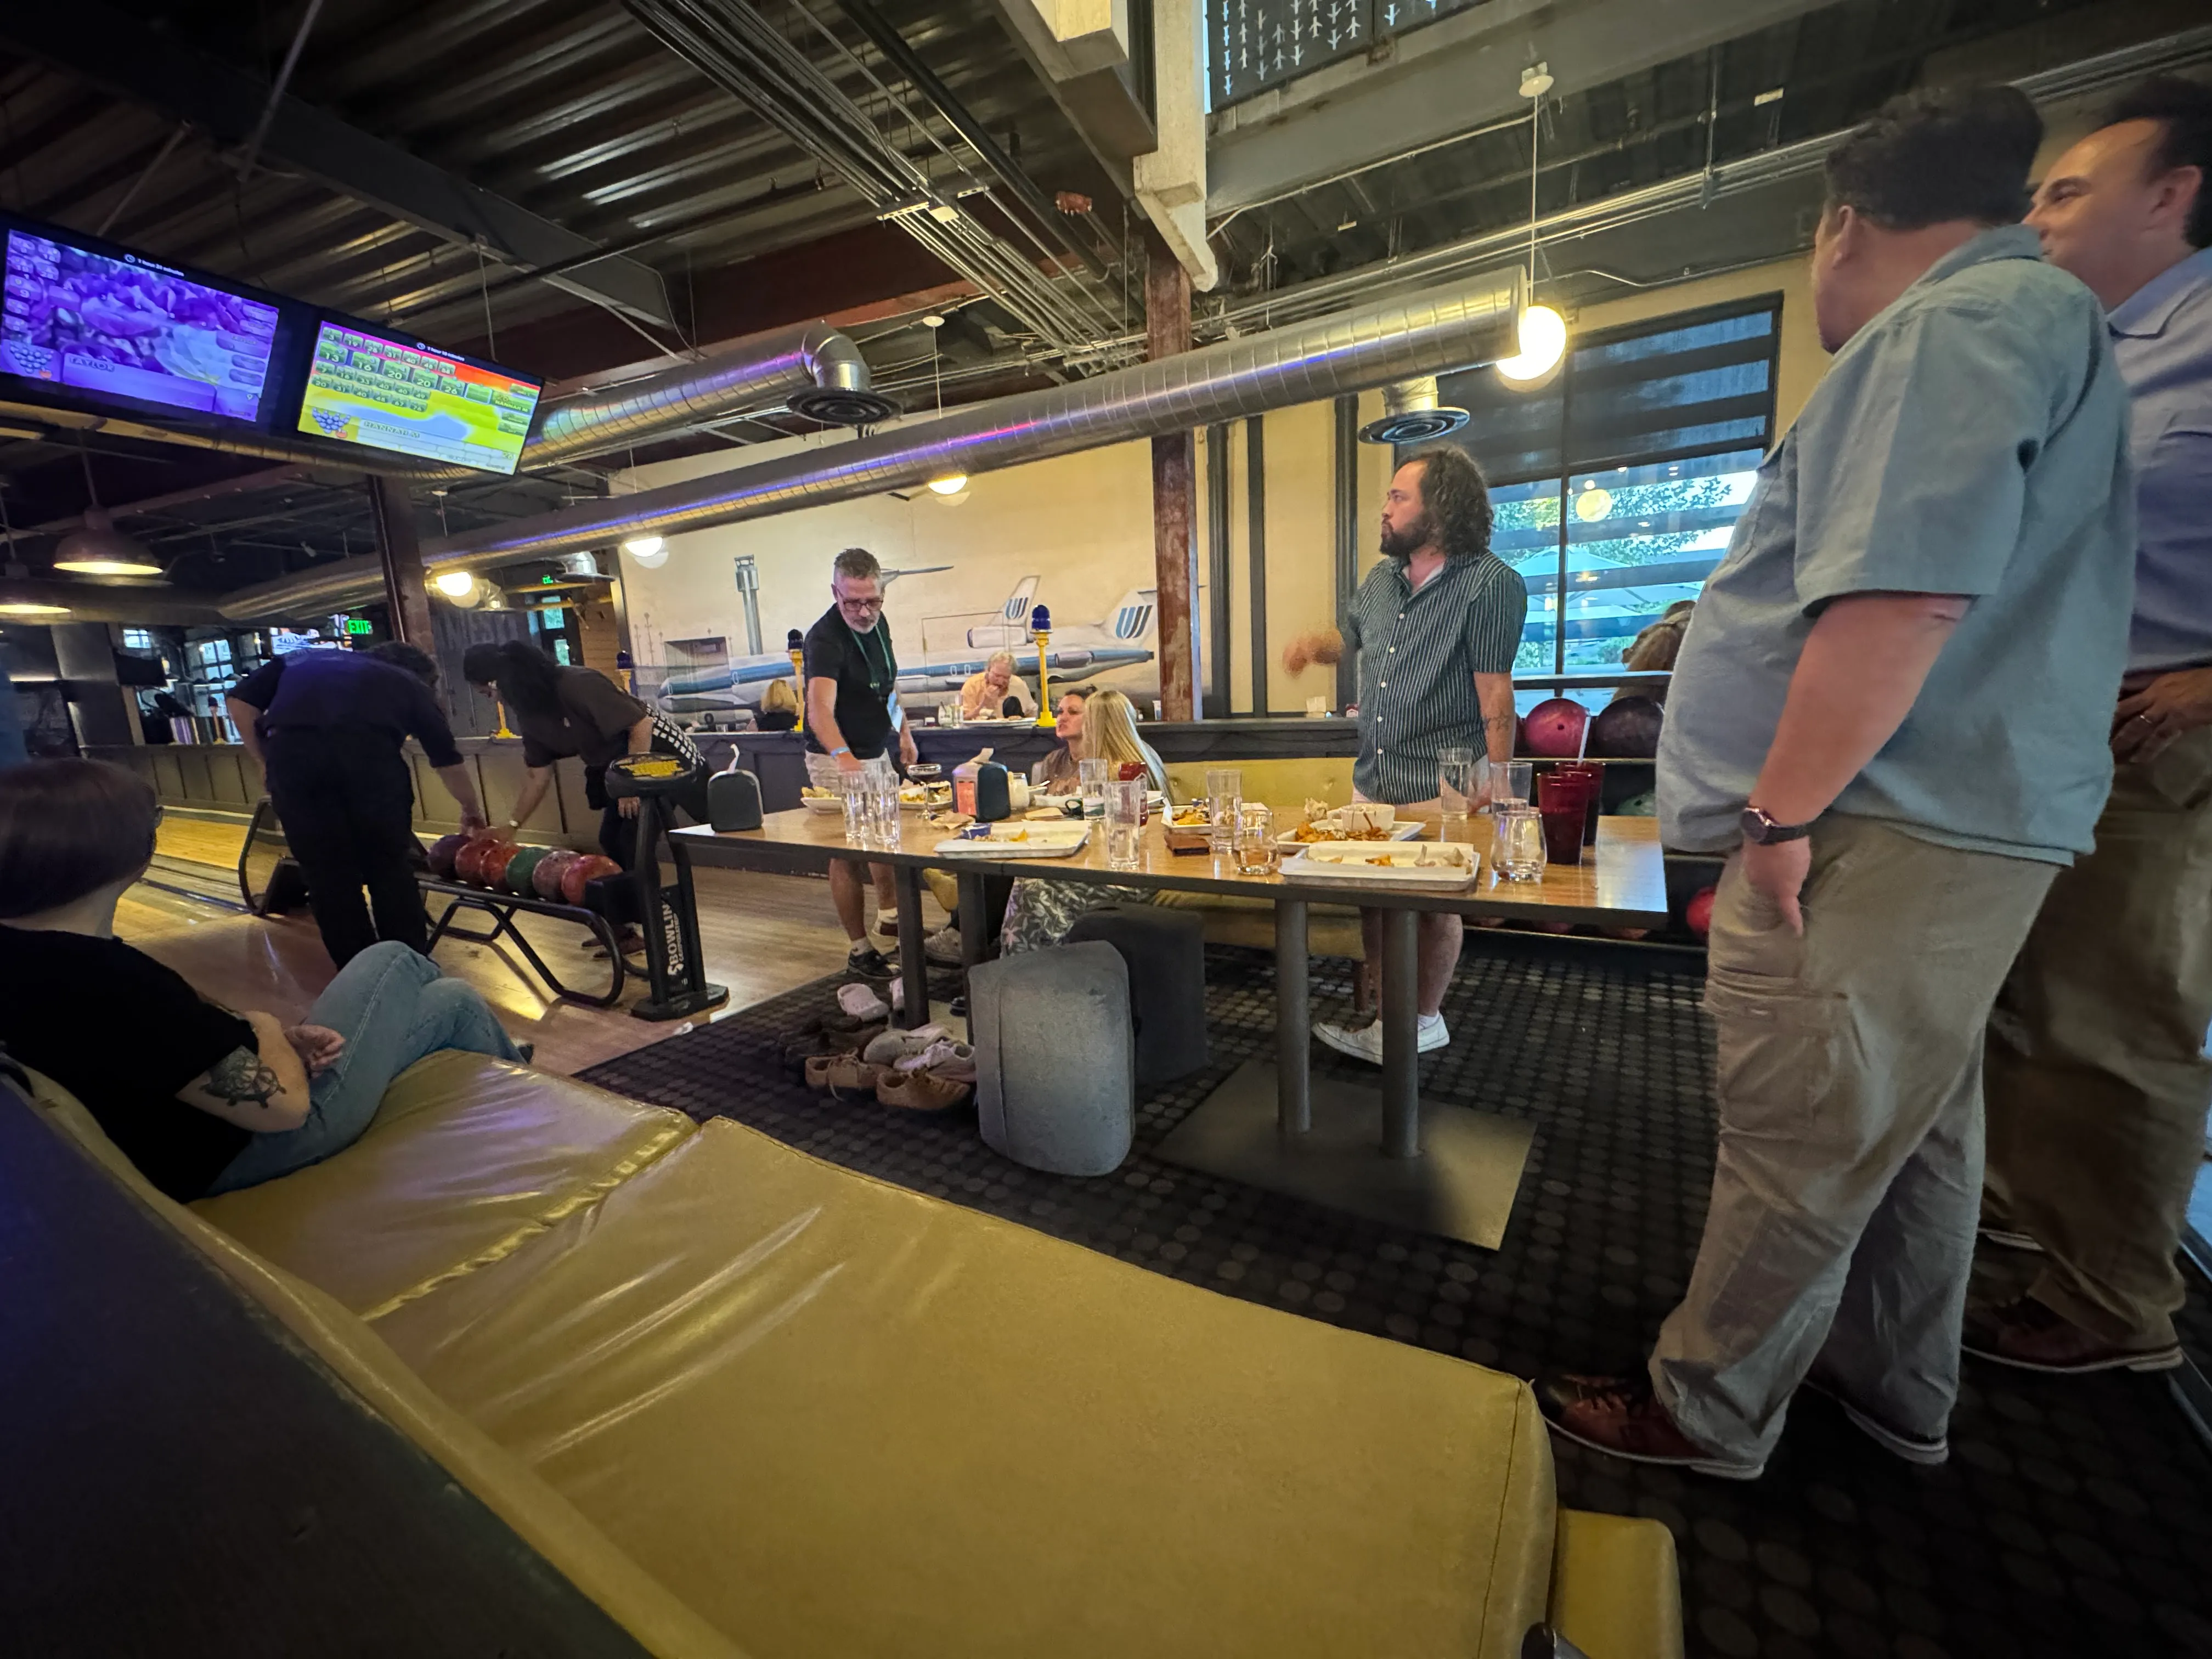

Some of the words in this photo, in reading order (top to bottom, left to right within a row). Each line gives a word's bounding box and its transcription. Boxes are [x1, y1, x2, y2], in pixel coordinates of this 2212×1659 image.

[326, 353, 340, 362] 13
[358, 362, 372, 371] 16
[387, 371, 402, 380] 20
[417, 379, 431, 387] 20
[348, 620, 369, 634] EXIT
[662, 904, 679, 965] BOWLIN
